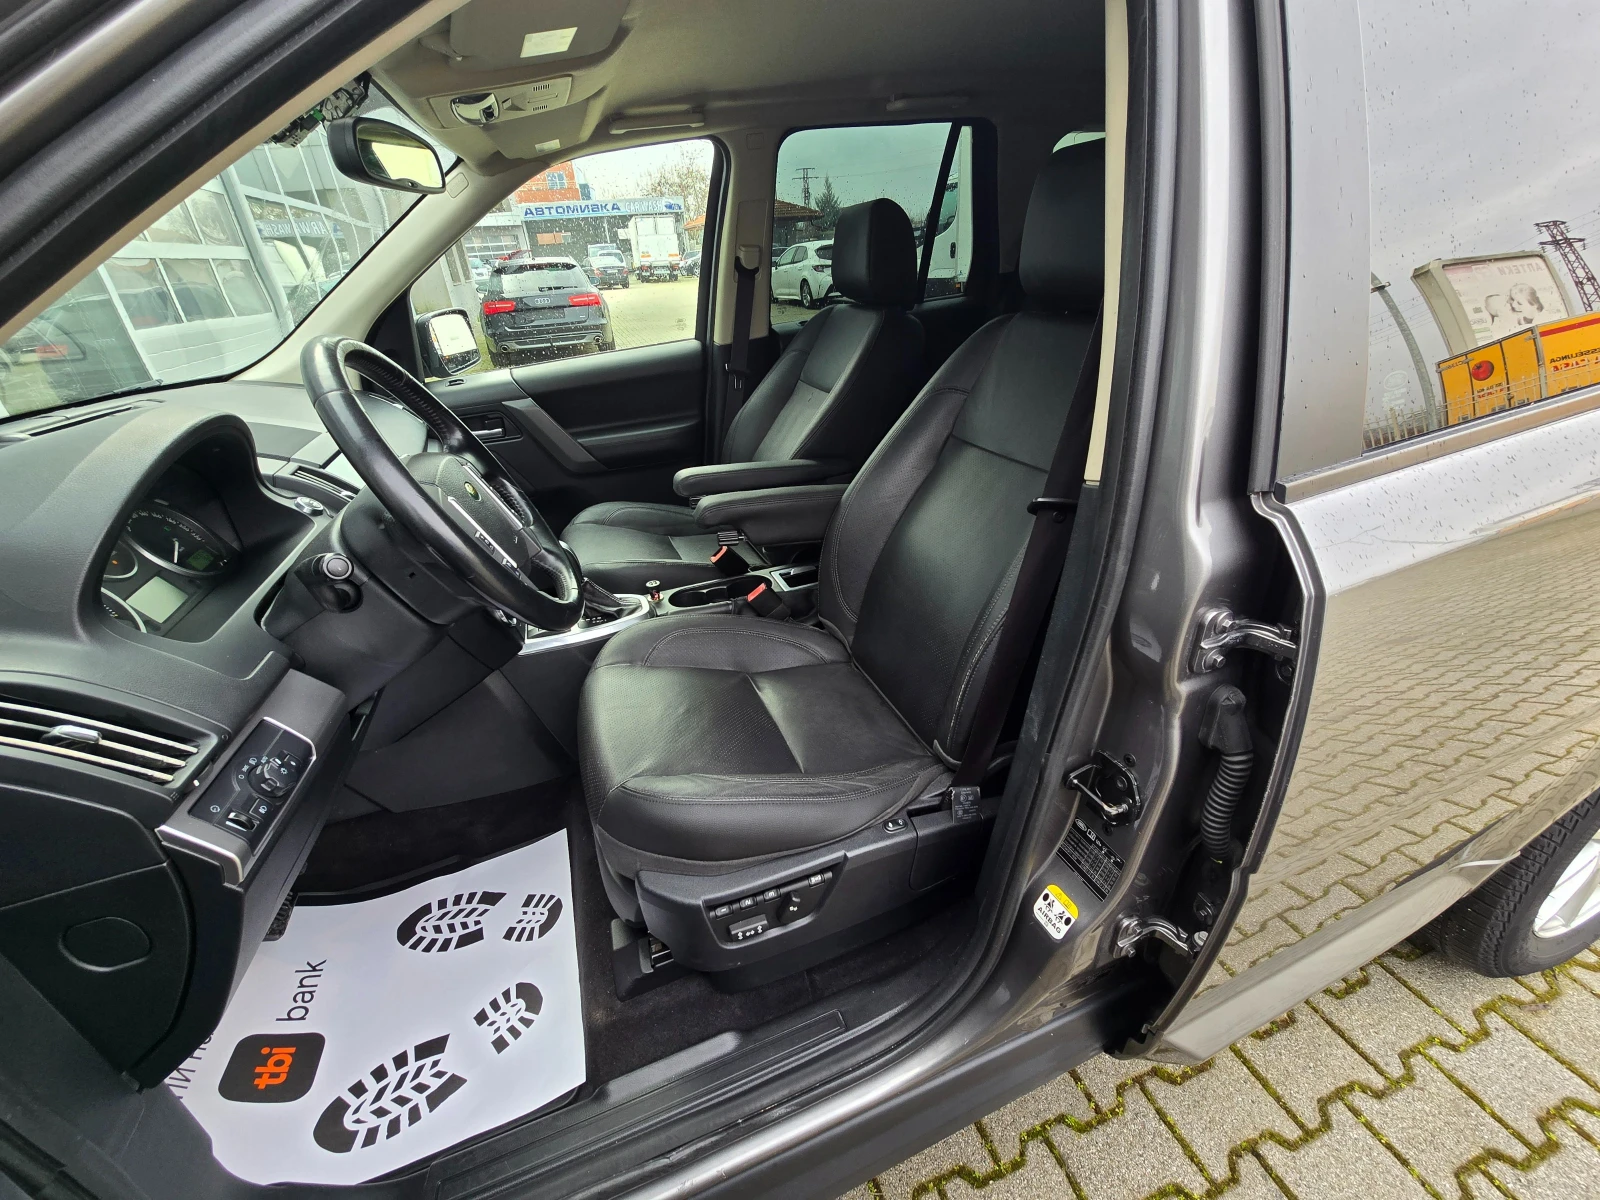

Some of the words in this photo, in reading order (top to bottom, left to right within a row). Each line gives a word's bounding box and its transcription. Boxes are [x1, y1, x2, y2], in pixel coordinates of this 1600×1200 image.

[524, 202, 621, 217] АВТОМИВКА
[1037, 906, 1062, 934] AIRBAG
[253, 1047, 297, 1090] tbi
[275, 959, 327, 1022] bank
